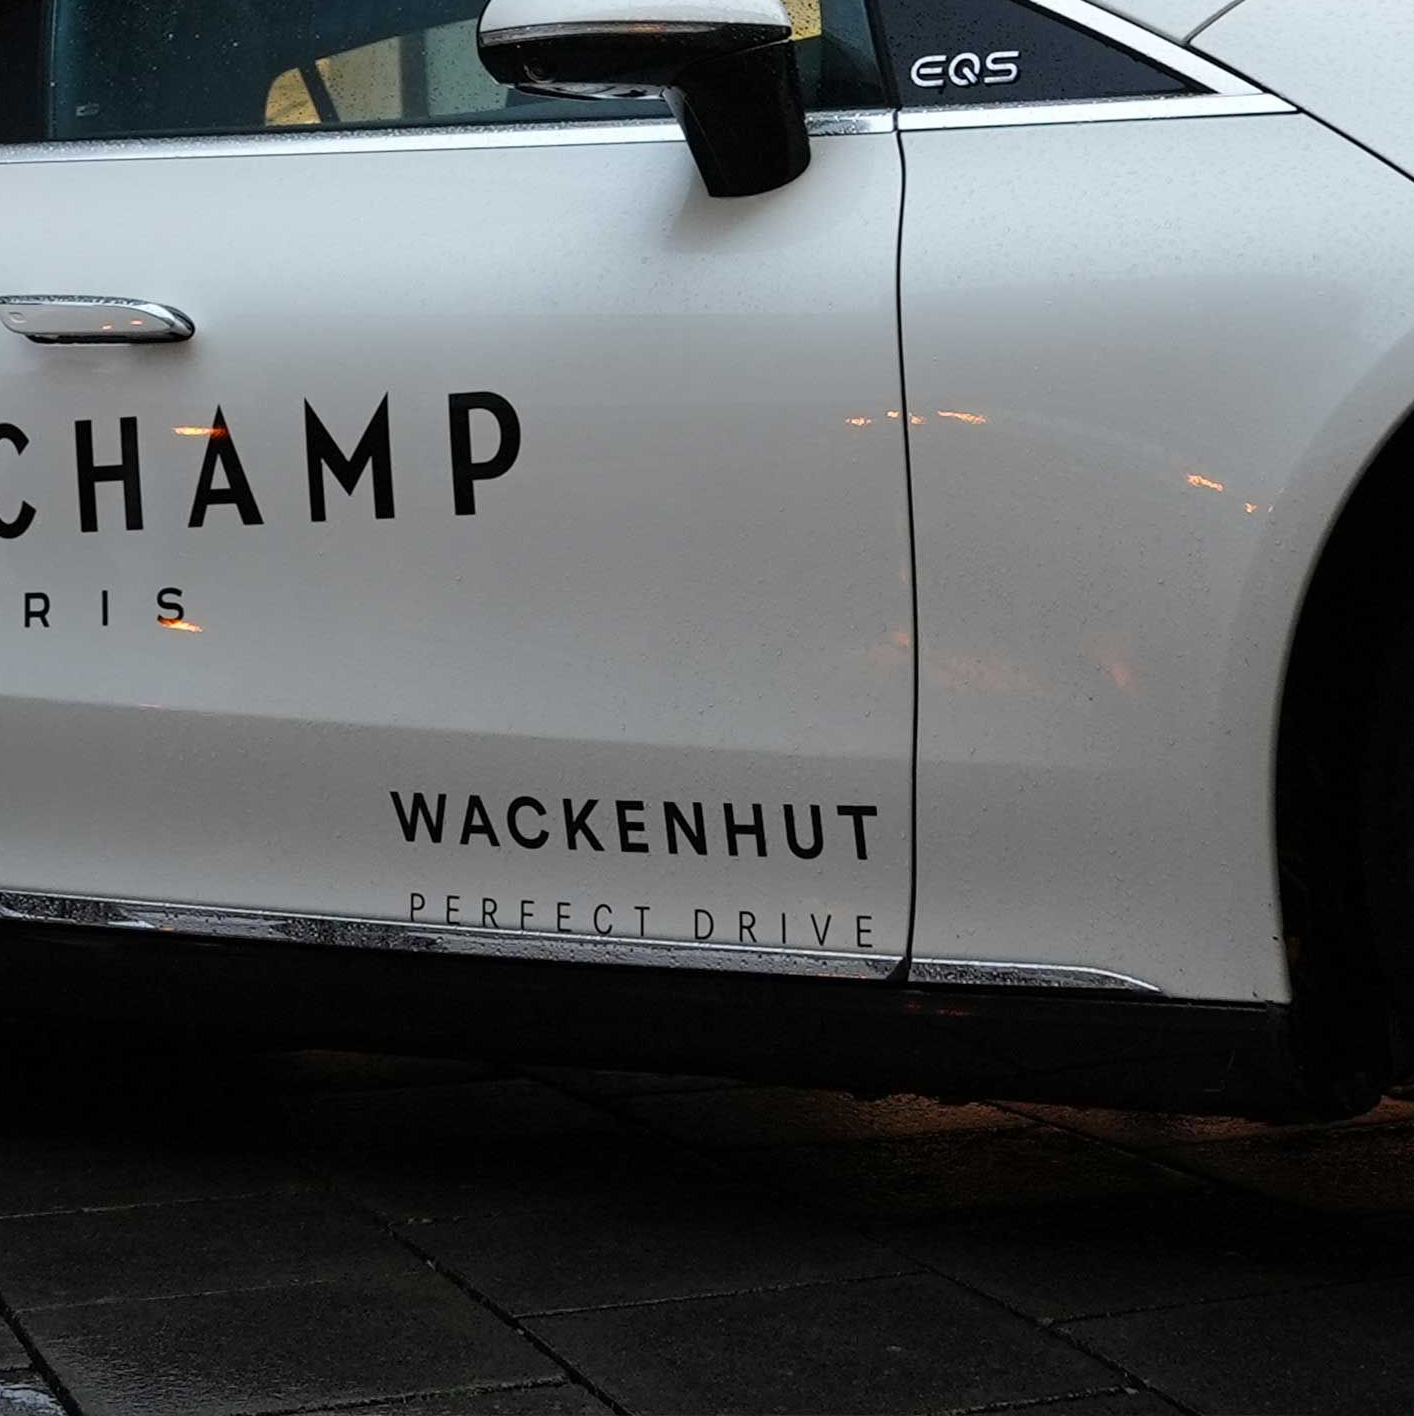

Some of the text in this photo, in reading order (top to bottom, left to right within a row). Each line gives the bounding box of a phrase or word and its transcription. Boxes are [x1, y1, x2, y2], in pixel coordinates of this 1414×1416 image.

[910, 50, 1019, 87] EQS
[389, 791, 878, 861] WACKENHUT
[409, 892, 874, 949] PERFECT DRIVE
